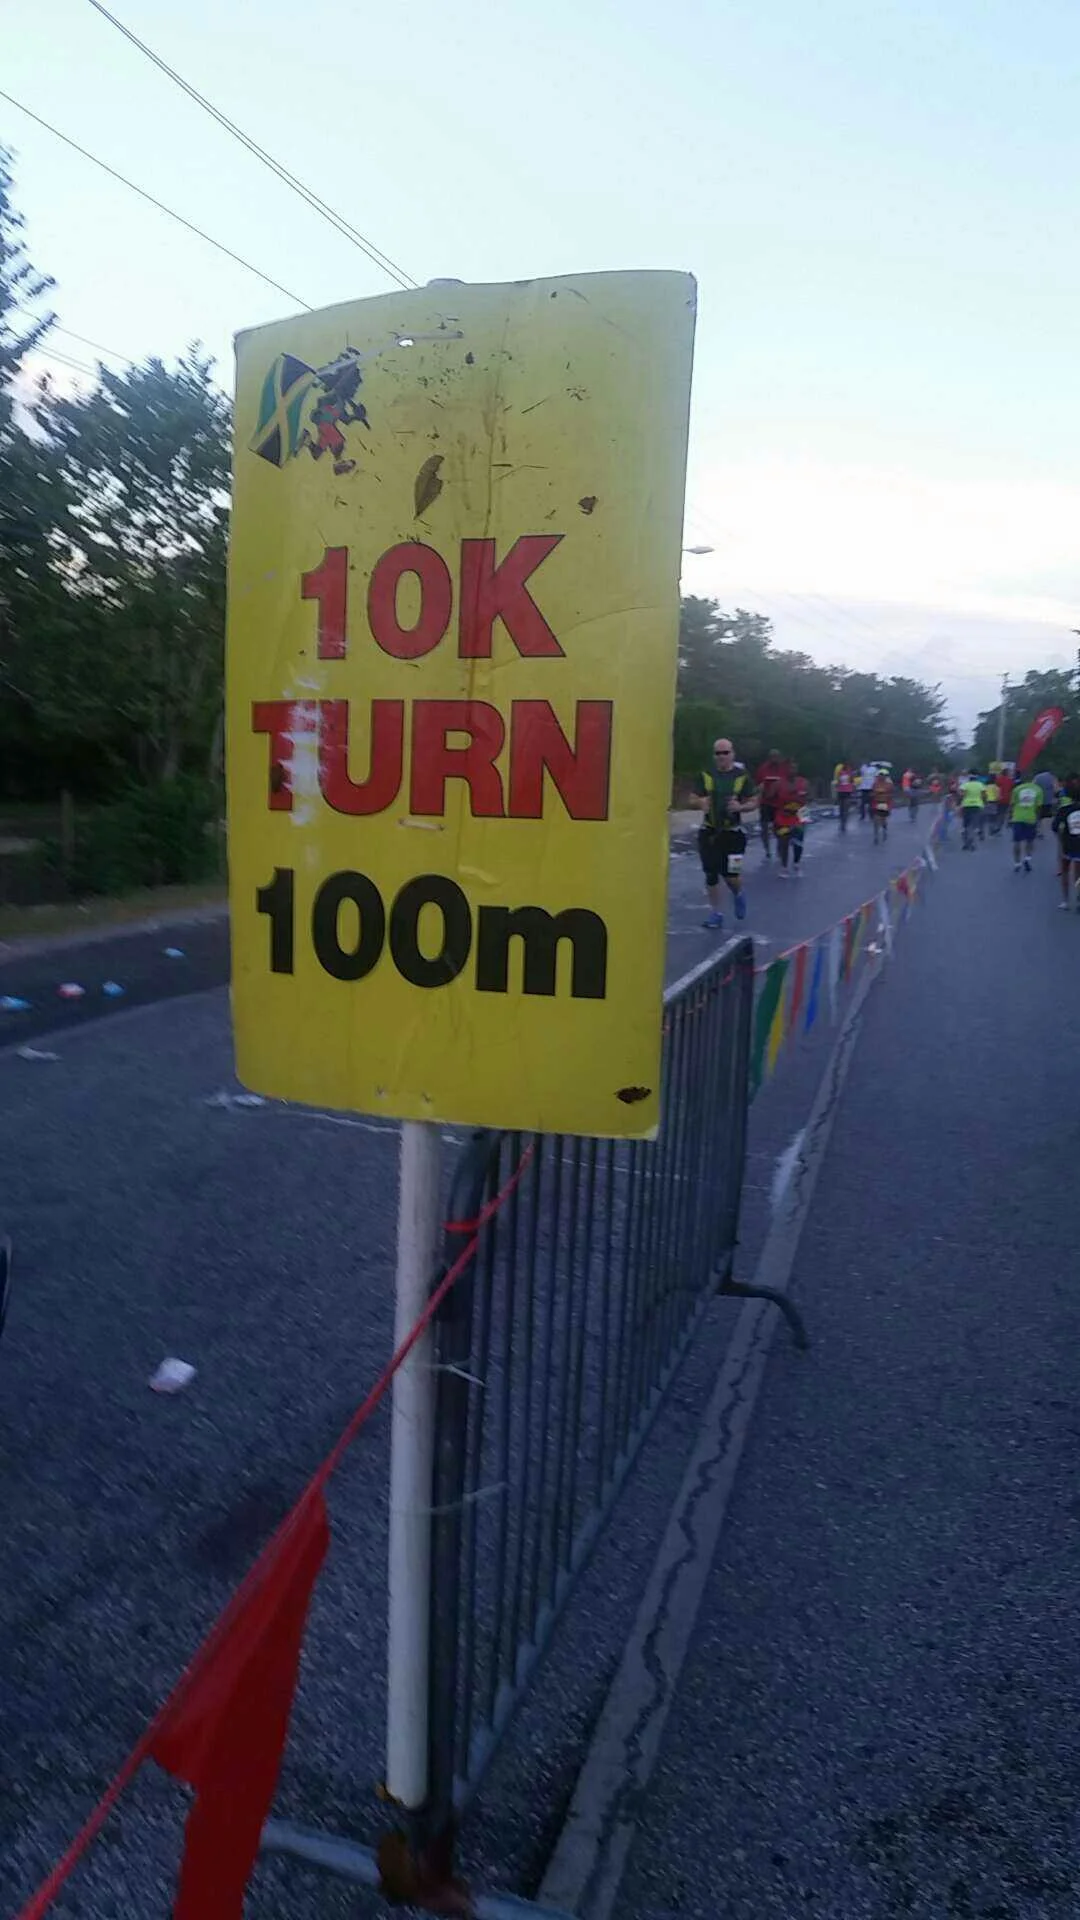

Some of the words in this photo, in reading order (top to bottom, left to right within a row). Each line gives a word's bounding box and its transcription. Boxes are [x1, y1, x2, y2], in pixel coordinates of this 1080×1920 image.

[301, 535, 566, 659] 10K
[252, 700, 613, 821] TURN
[256, 867, 608, 999] 100m
